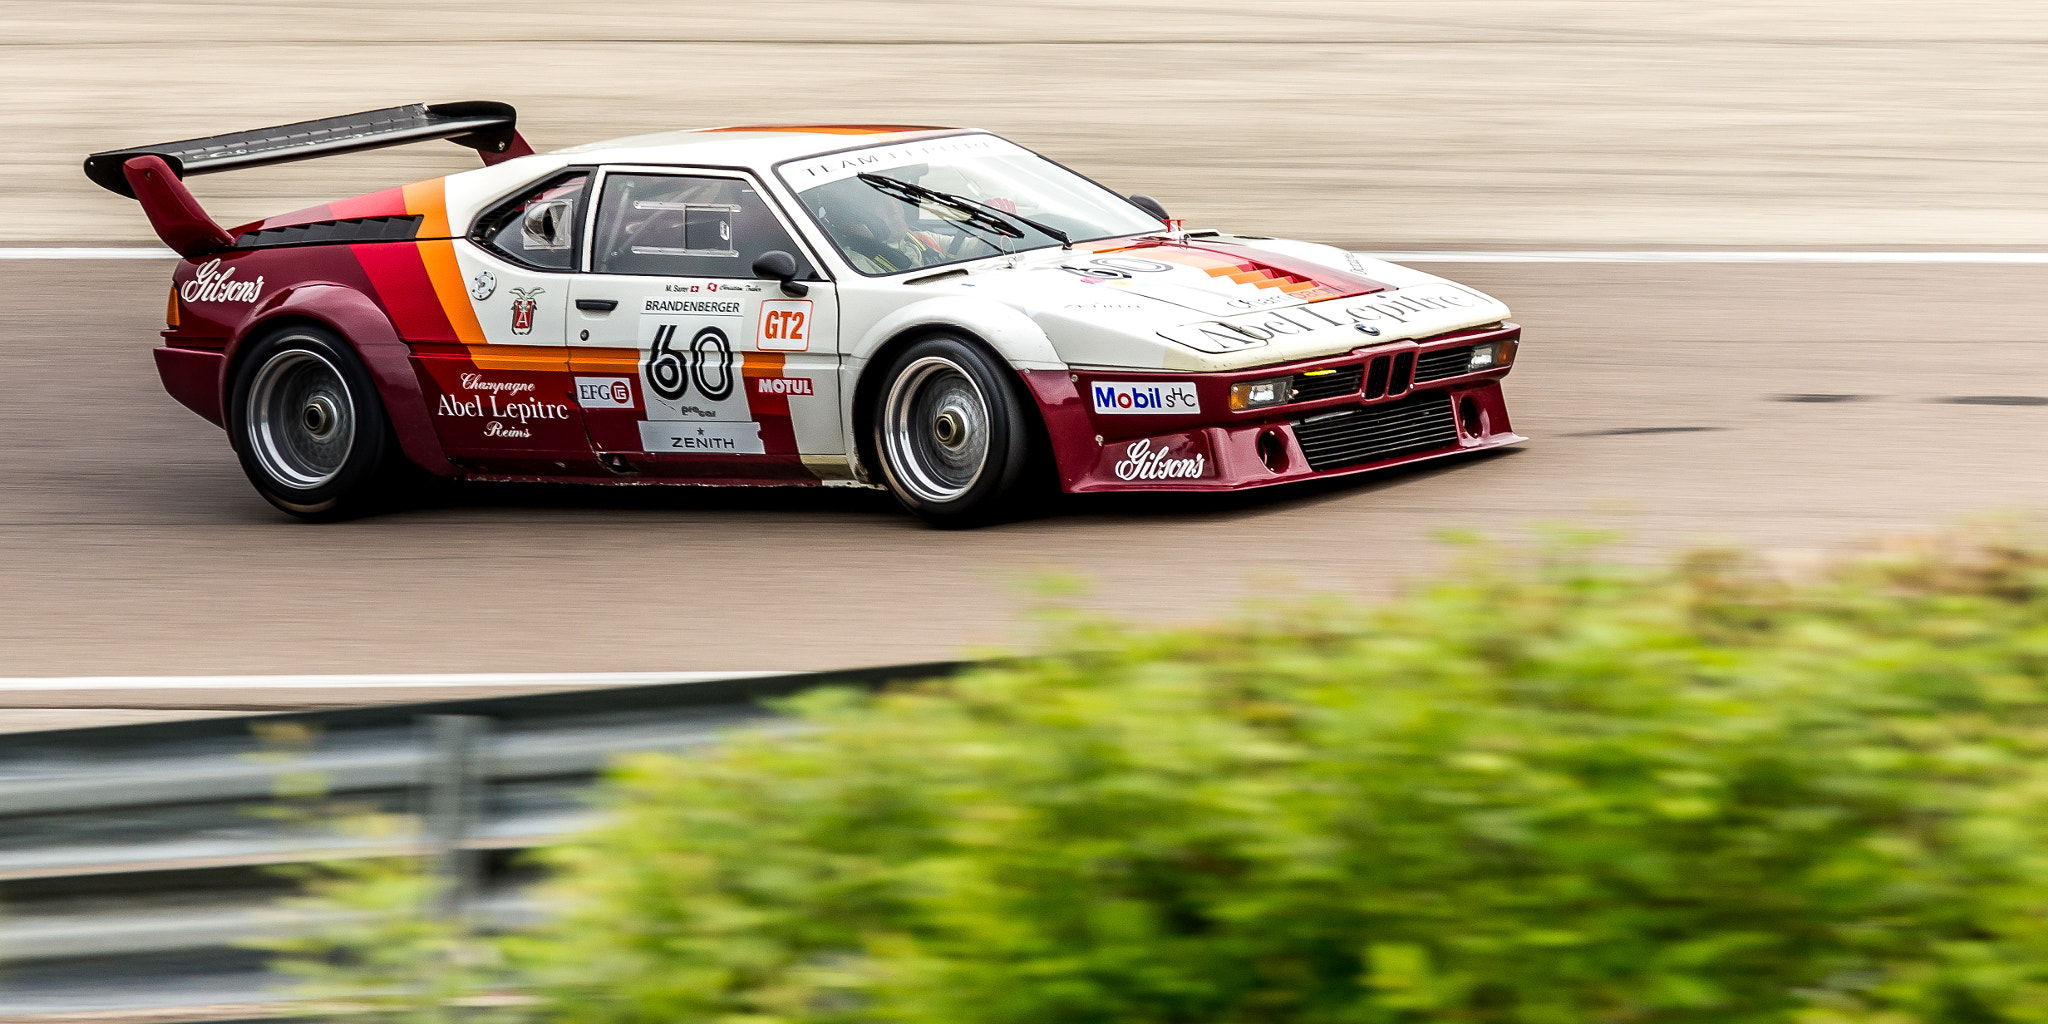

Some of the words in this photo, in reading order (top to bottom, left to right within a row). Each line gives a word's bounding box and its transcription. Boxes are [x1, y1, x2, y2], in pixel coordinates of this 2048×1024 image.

[803, 154, 879, 177] TEAM
[181, 258, 264, 303] Gibson's
[645, 300, 740, 313] BRANDENBERGER
[764, 310, 805, 340] GT2
[1199, 311, 1315, 349] Abel
[645, 324, 734, 401] 60
[460, 372, 536, 396] Champagne
[578, 384, 611, 401] EFG
[758, 378, 812, 394] MOTUL
[437, 393, 485, 417] Abel
[1095, 386, 1162, 409] Mobil
[483, 420, 532, 438] Reims
[670, 437, 735, 449] ZENITH
[1115, 438, 1205, 481] Gibson's
